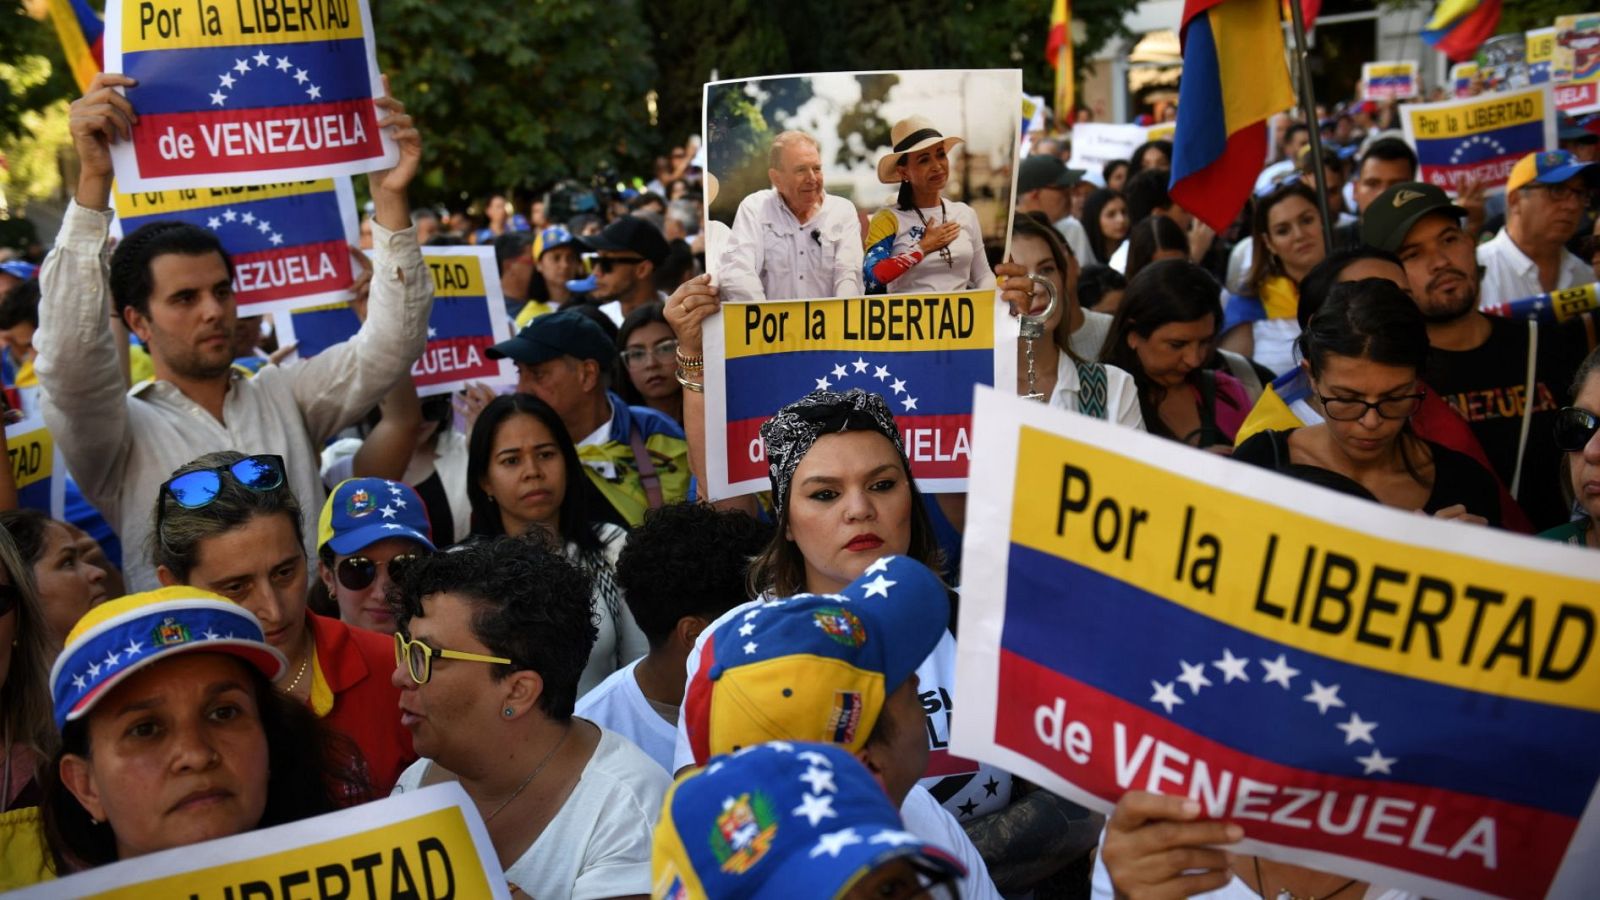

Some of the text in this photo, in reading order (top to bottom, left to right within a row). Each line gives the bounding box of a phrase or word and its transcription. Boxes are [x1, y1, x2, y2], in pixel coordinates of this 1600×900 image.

[140, 0, 350, 40] Por la LIBERTAD
[158, 111, 368, 160] de VENEZUELA
[1419, 98, 1534, 134] Por la LIBERTAD
[745, 297, 974, 345] Por la LIBERTAD
[749, 436, 766, 463] d
[1056, 462, 1597, 684] Por la LIBERTAD
[1034, 697, 1498, 870] de VENEZUELA
